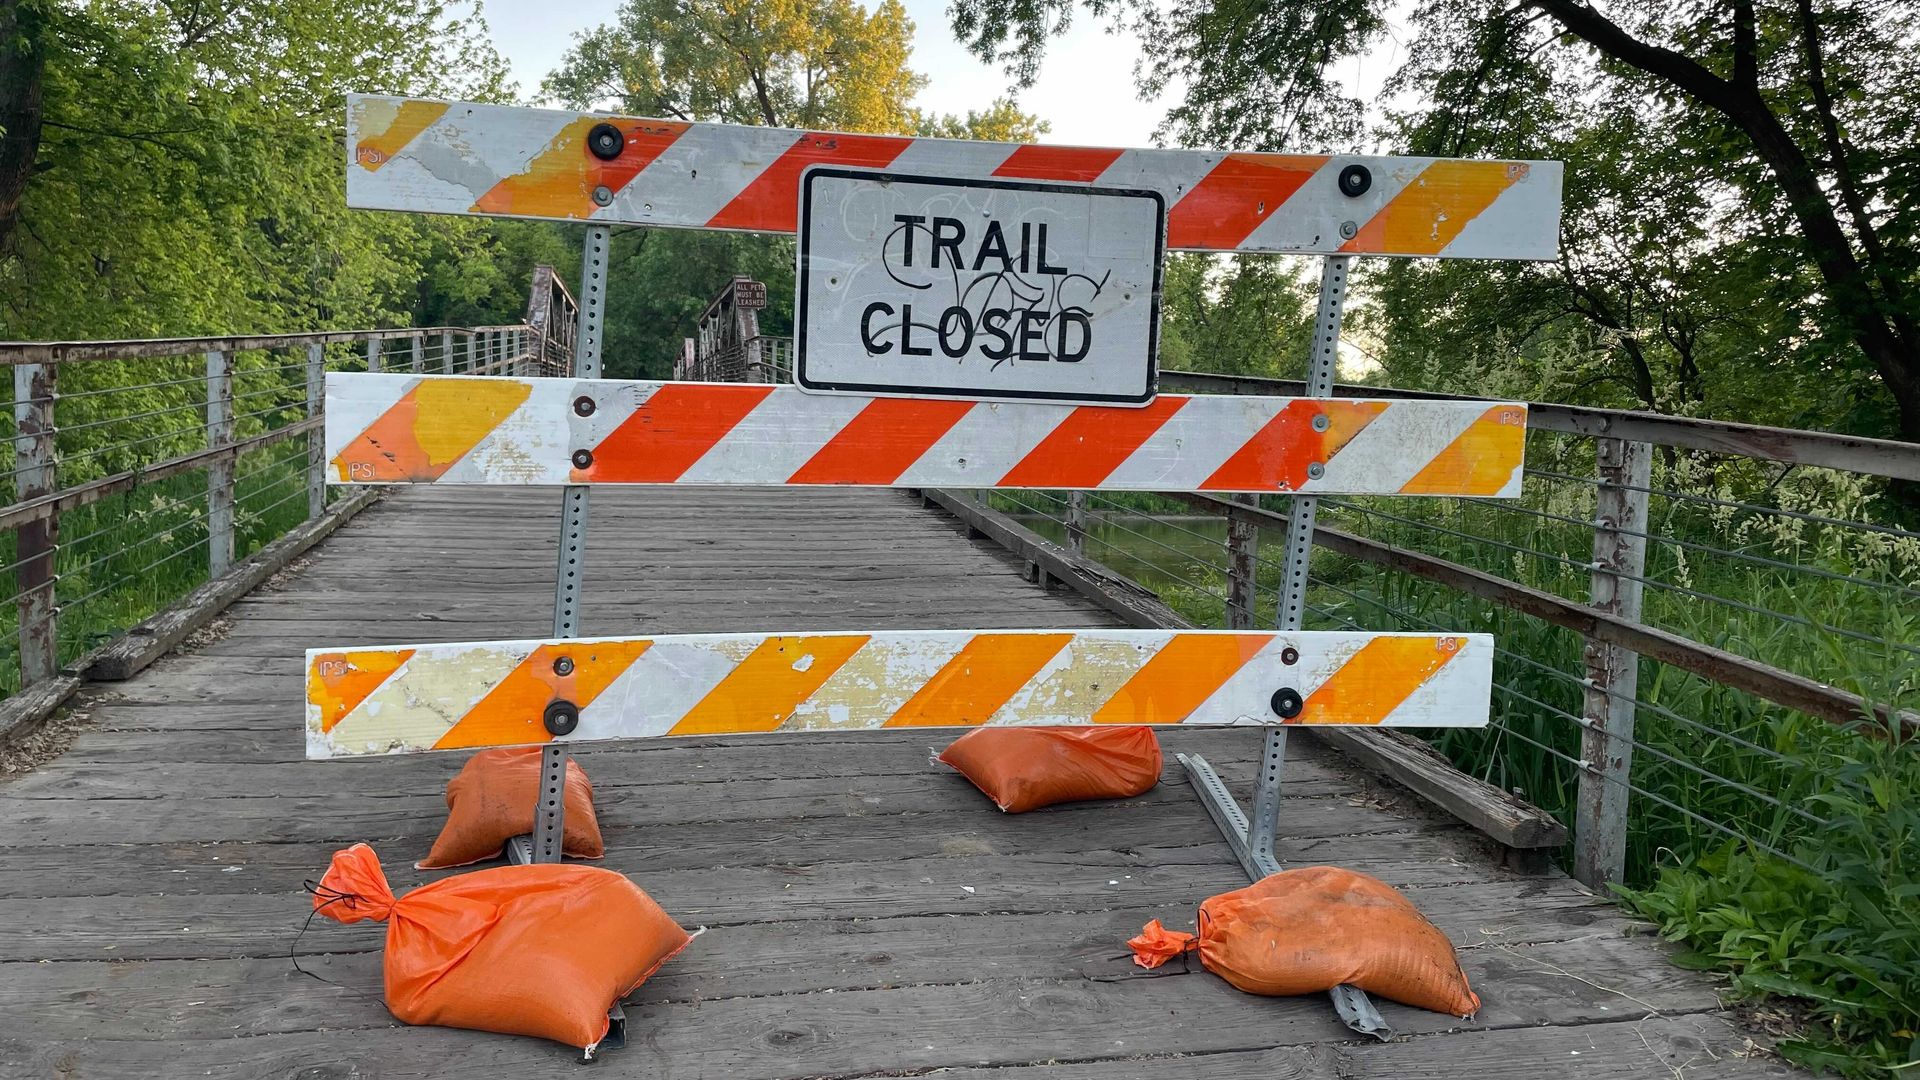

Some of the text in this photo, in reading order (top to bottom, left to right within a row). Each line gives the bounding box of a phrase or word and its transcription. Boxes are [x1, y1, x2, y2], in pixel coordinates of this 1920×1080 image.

[894, 214, 1068, 276] TRAIL
[736, 291, 753, 299] MUST
[860, 301, 1092, 363] CLOSED
